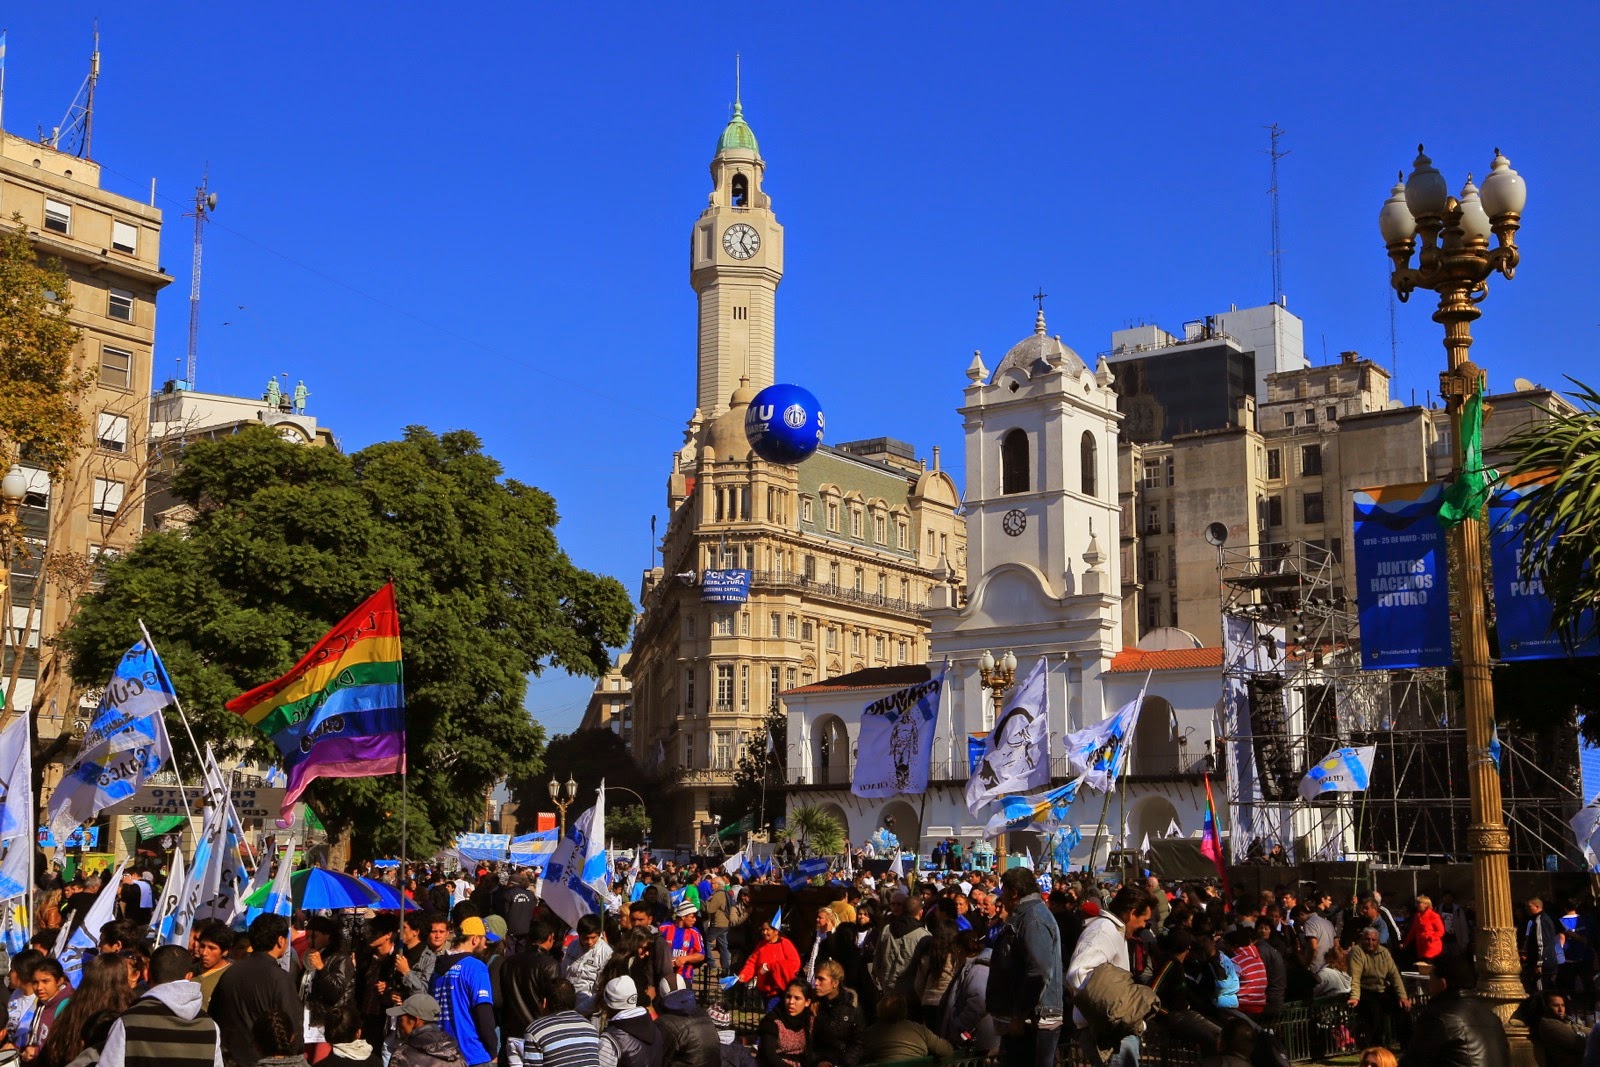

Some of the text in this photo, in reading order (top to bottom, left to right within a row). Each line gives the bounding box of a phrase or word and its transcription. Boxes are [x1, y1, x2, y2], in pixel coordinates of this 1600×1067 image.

[1400, 534, 1417, 543] MAYO
[1376, 558, 1426, 577] JUNTOS
[1370, 574, 1434, 593] HACEMOS
[1510, 580, 1546, 597] POPU
[1377, 590, 1428, 608] FUTURO
